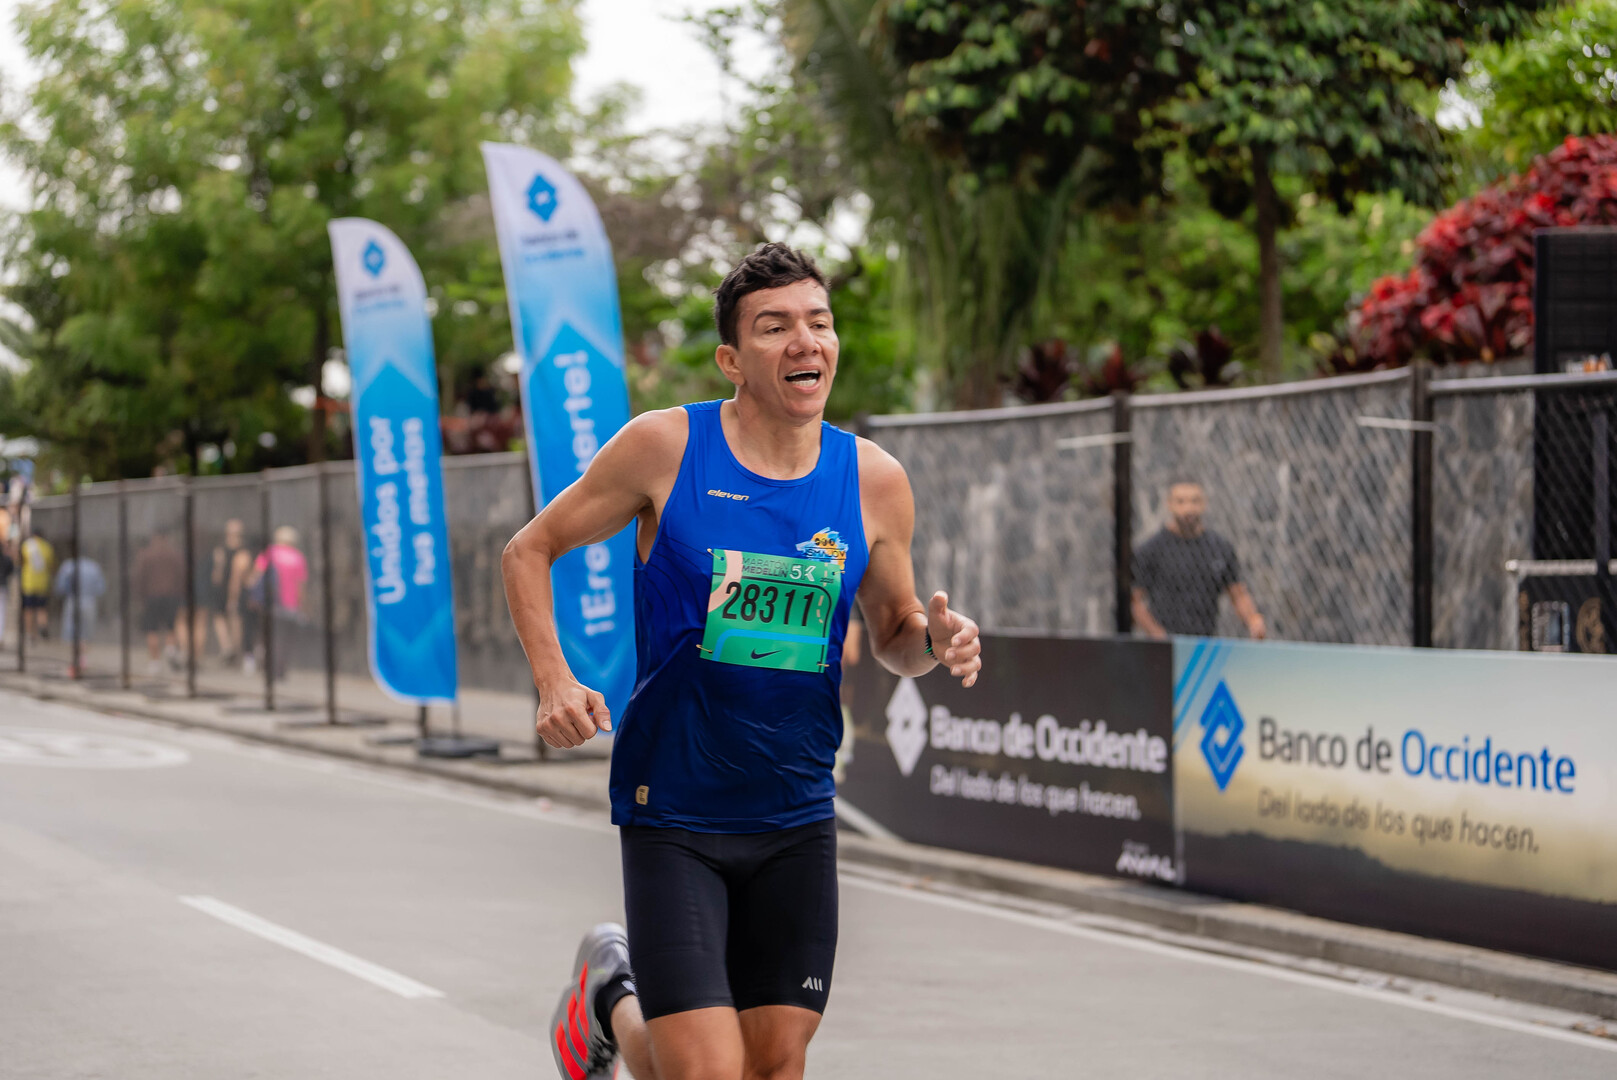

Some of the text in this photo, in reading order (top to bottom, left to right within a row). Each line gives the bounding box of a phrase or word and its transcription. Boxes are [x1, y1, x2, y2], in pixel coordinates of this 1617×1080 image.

[369, 415, 406, 605] Unidos por
[402, 416, 435, 586] tus metas
[707, 489, 750, 501] eleven
[742, 557, 788, 570] MARATÓN
[742, 565, 789, 578] MEDELLÍN
[789, 564, 816, 582] 5K
[722, 581, 815, 627] 28311
[930, 704, 1167, 773] Banco de Occidente
[1258, 716, 1577, 794] Banco de Occidente
[930, 764, 1142, 821] Del lado de los que hacen.
[1257, 787, 1541, 854] Del lado de los que hacen.
